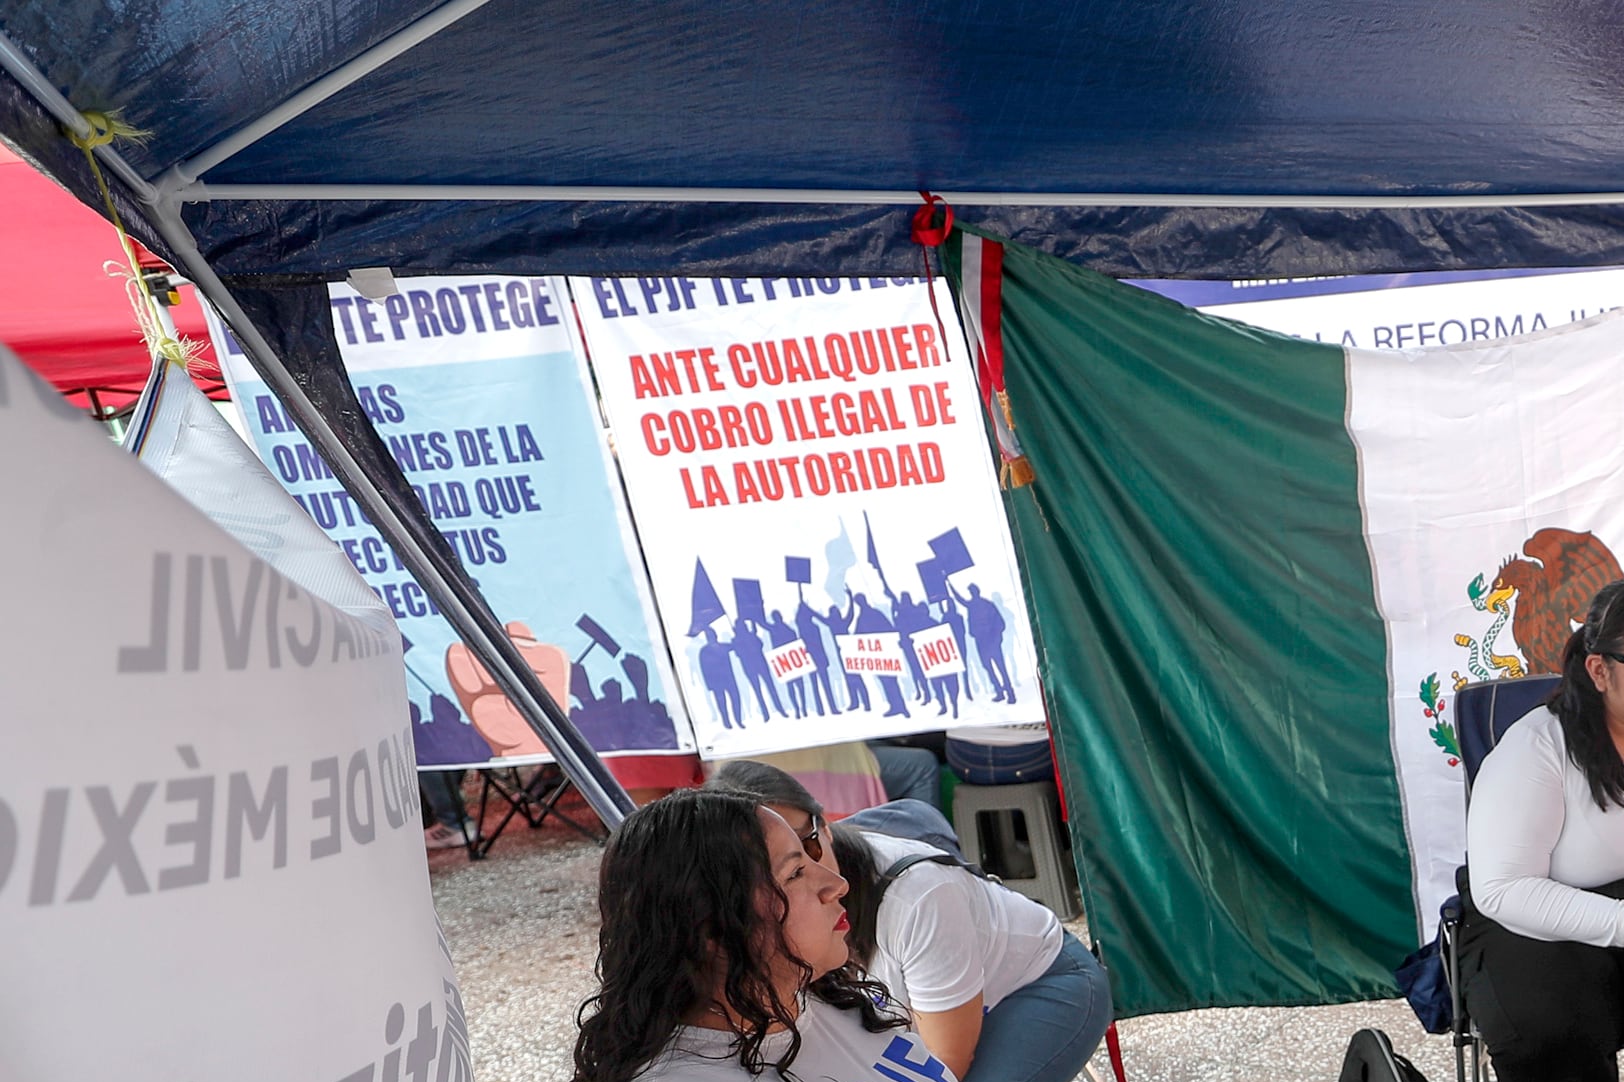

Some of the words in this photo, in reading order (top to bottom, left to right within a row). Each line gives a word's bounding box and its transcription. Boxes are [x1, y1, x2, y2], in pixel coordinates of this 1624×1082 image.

[331, 293, 385, 346] TE
[387, 278, 560, 341] PROTEGE
[590, 275, 638, 319] EL
[645, 275, 697, 315] PJF
[628, 347, 726, 400] ANTE
[726, 322, 942, 389] CUALQUIER
[361, 383, 406, 425] AS
[640, 401, 774, 457] COBRO
[776, 387, 907, 443] ILEGAL
[908, 380, 957, 427] DE
[456, 428, 492, 470] DE
[496, 423, 545, 464] LA
[474, 475, 542, 519] QUE
[679, 464, 730, 510] LA
[732, 441, 946, 505] AUTORIDAD
[845, 656, 903, 673] REFORMA
[857, 638, 866, 652] A
[867, 638, 883, 653] LA
[917, 636, 959, 673] ¡NO!
